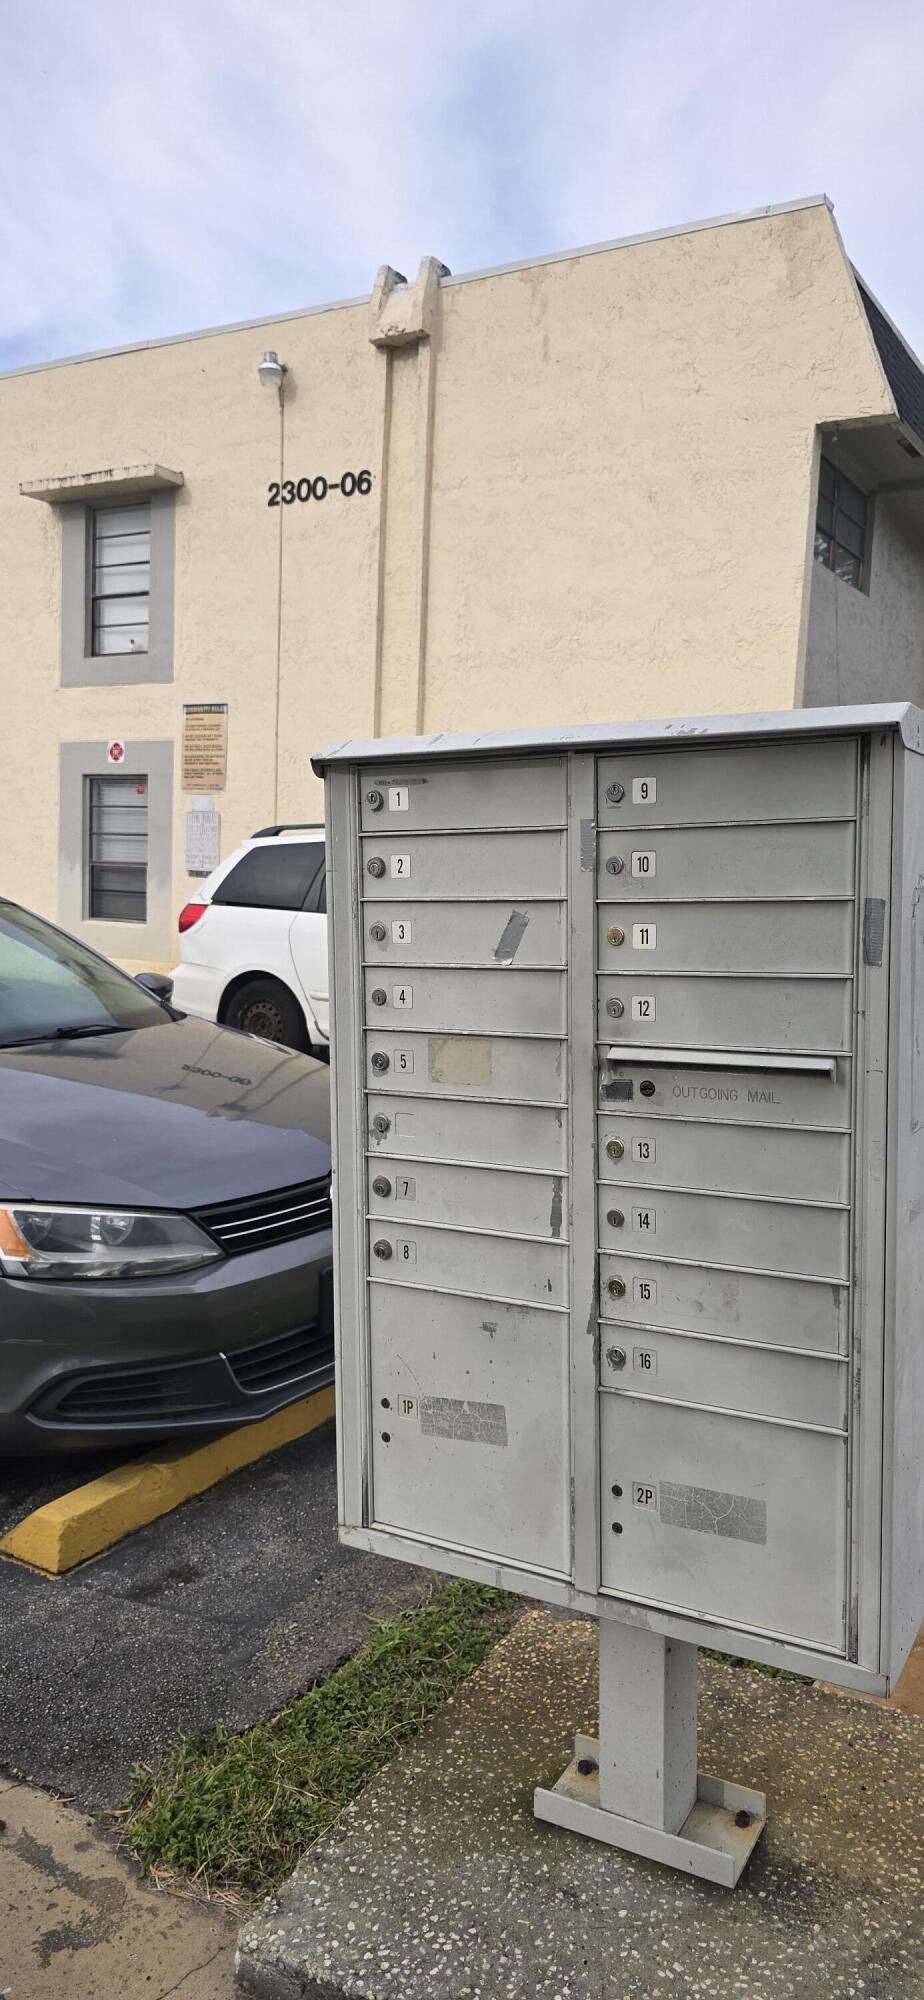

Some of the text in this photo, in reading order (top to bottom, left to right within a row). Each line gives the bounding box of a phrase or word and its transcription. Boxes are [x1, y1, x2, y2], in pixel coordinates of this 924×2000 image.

[267, 469, 373, 507] 2300-06
[395, 791, 402, 808] 1
[640, 782, 649, 800] 9
[397, 858, 404, 874] 2
[637, 855, 650, 873] 10
[397, 924, 405, 940] 3
[638, 928, 650, 945] 11
[398, 989, 406, 1005] 4
[637, 1000, 650, 1017] 12
[399, 1053, 407, 1069] 5
[672, 1085, 780, 1104] OUTGOING MAIL
[637, 1141, 650, 1159] 13
[402, 1181, 410, 1197] 7
[637, 1212, 651, 1230] 14
[402, 1244, 410, 1261] 8
[639, 1282, 651, 1301] 15
[639, 1352, 652, 1370] 16
[401, 1399, 414, 1415] 1P
[636, 1487, 654, 1505] 2P
